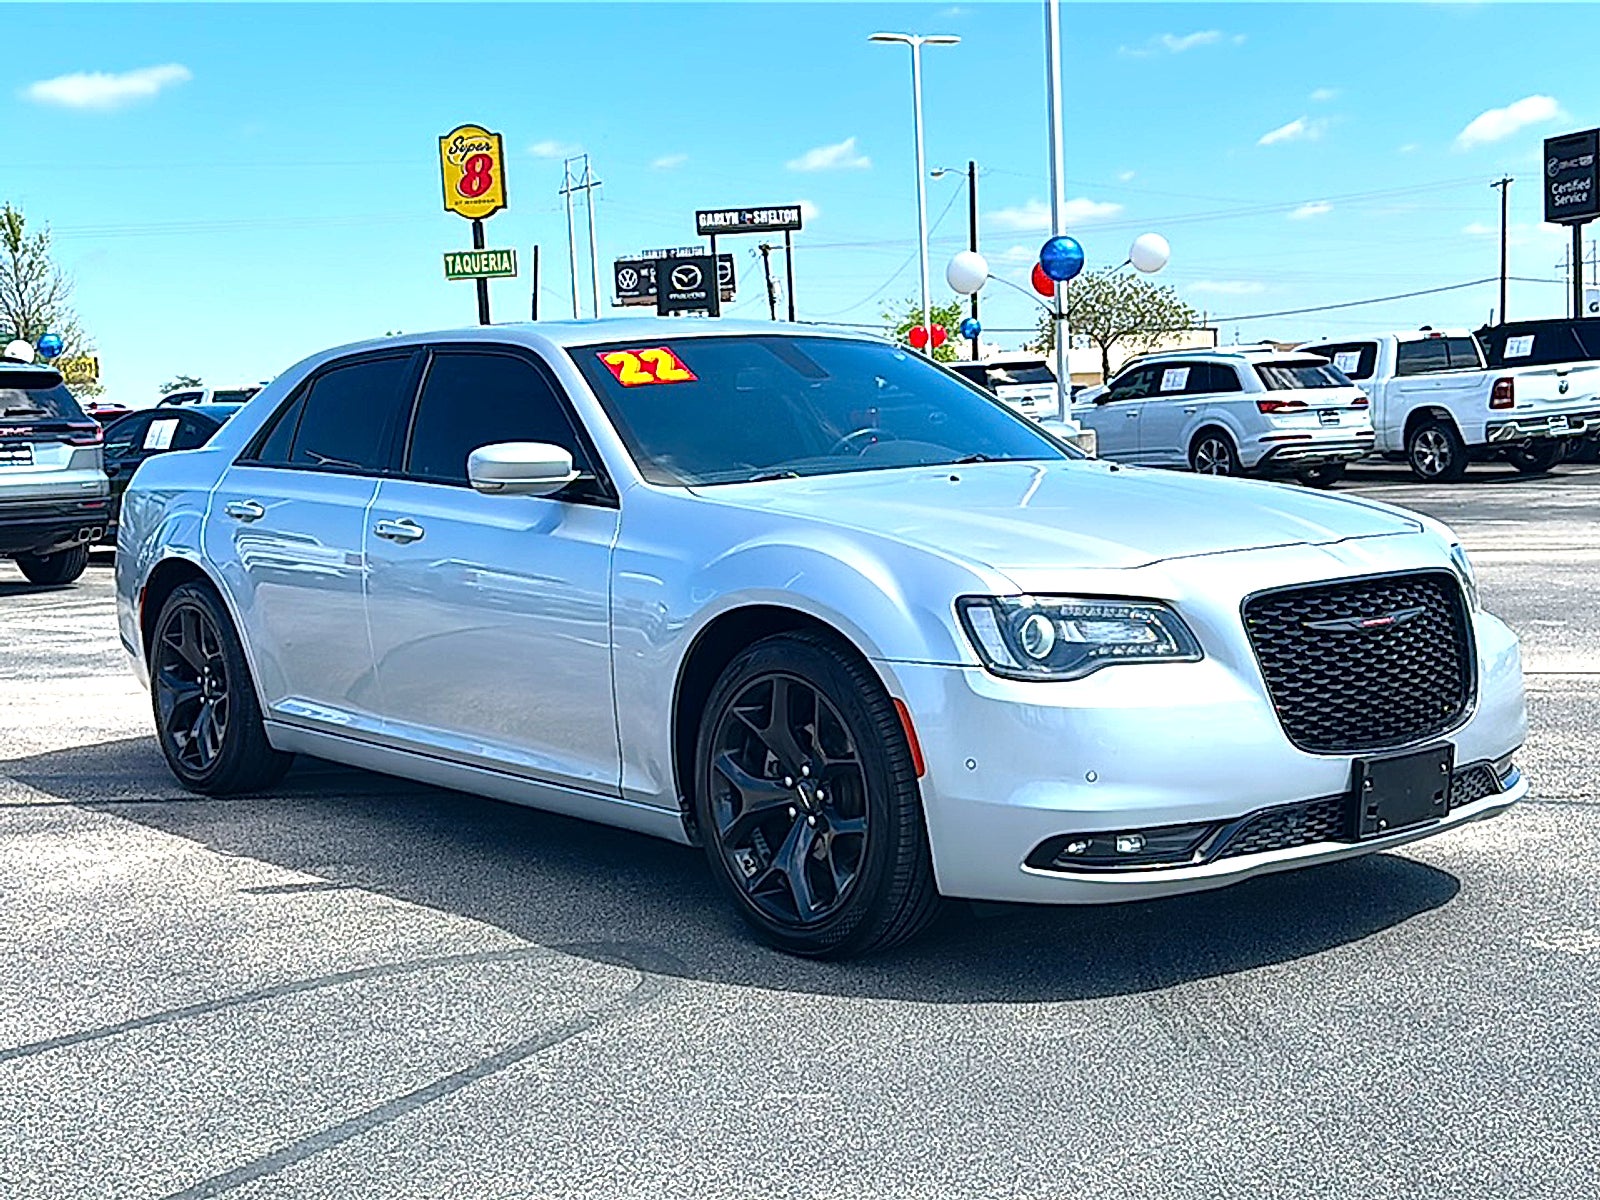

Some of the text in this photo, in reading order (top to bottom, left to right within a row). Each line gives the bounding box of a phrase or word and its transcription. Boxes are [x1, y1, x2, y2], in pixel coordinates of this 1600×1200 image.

[449, 136, 493, 162] Super
[459, 153, 494, 198] 8
[1551, 177, 1592, 195] Certified
[1554, 191, 1588, 207] Service
[699, 209, 798, 227] GARLYN SHELTON
[445, 252, 511, 274] TAQUERIA
[668, 291, 706, 300] mazda
[604, 349, 691, 384] 22
